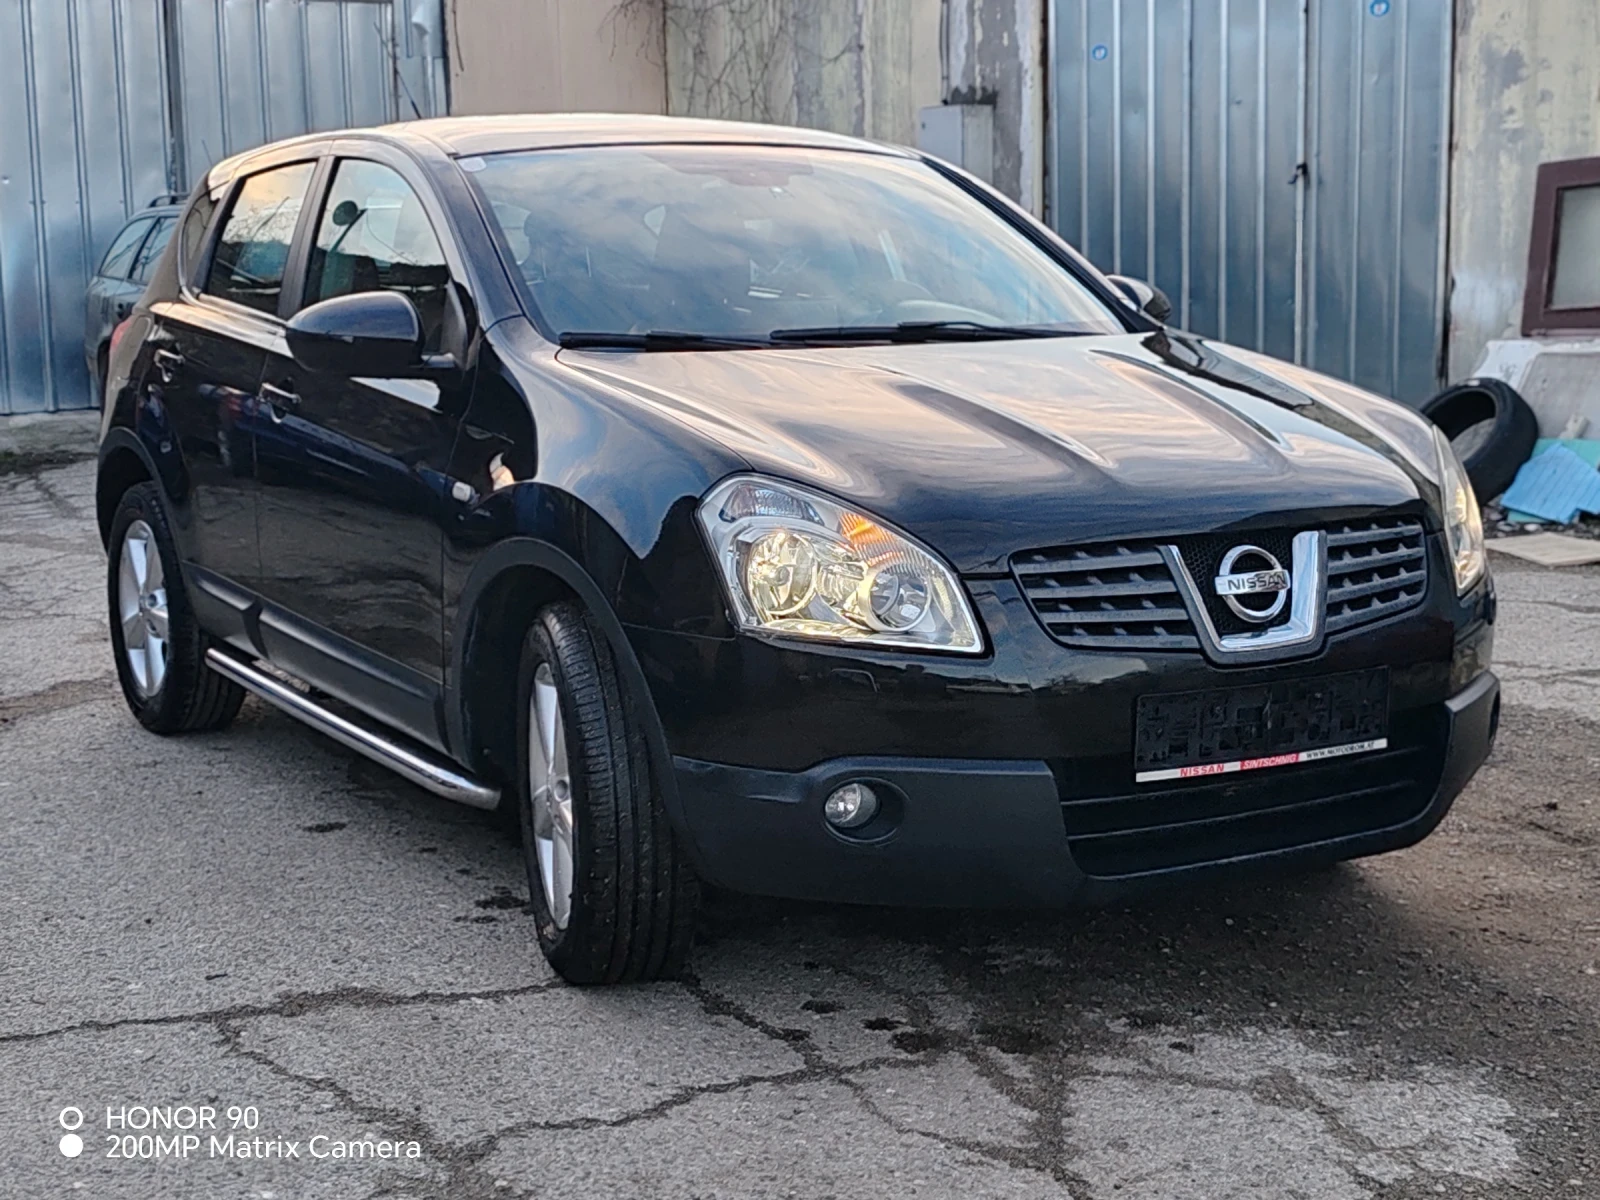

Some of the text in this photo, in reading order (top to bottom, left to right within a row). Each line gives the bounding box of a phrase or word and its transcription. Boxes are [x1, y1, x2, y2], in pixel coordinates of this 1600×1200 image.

[1227, 571, 1287, 591] NISSAN
[1180, 763, 1224, 777] NISSAN
[1243, 754, 1296, 769] SINTSCHNIG
